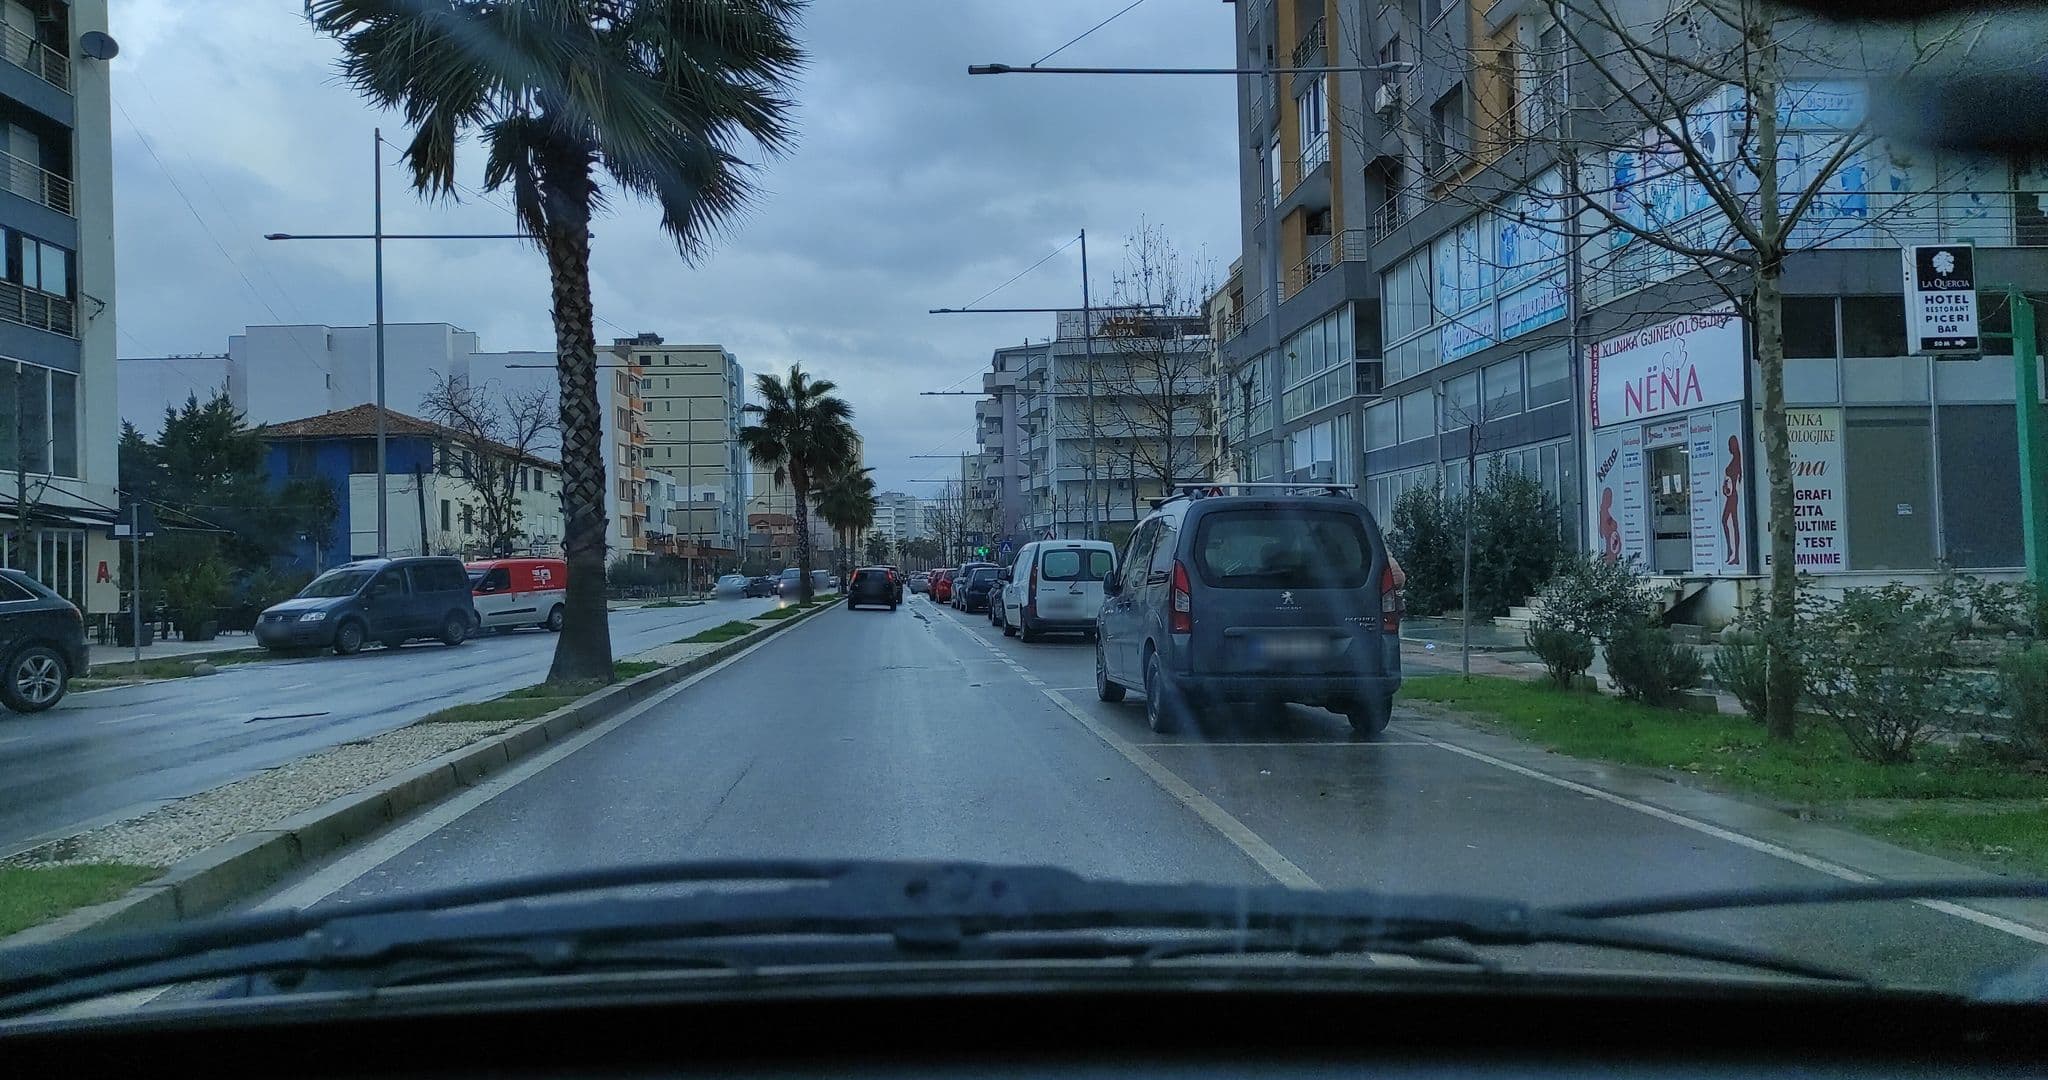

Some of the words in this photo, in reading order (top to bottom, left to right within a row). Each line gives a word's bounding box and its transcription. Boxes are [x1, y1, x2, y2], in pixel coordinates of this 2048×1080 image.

[1921, 280, 1933, 288] LA
[1934, 278, 1970, 289] QUERCIA
[1925, 295, 1969, 304] HOTEL
[1926, 315, 1969, 323] PICERI
[1937, 325, 1958, 333] BAR
[1602, 334, 1639, 358] KLINIKA
[1624, 364, 1704, 417] NËNA
[1788, 414, 1823, 426] INIKA
[1793, 489, 1832, 501] GRAFI
[1793, 505, 1824, 517] ZITA
[1803, 537, 1834, 549] TEST
[96, 560, 110, 584] A
